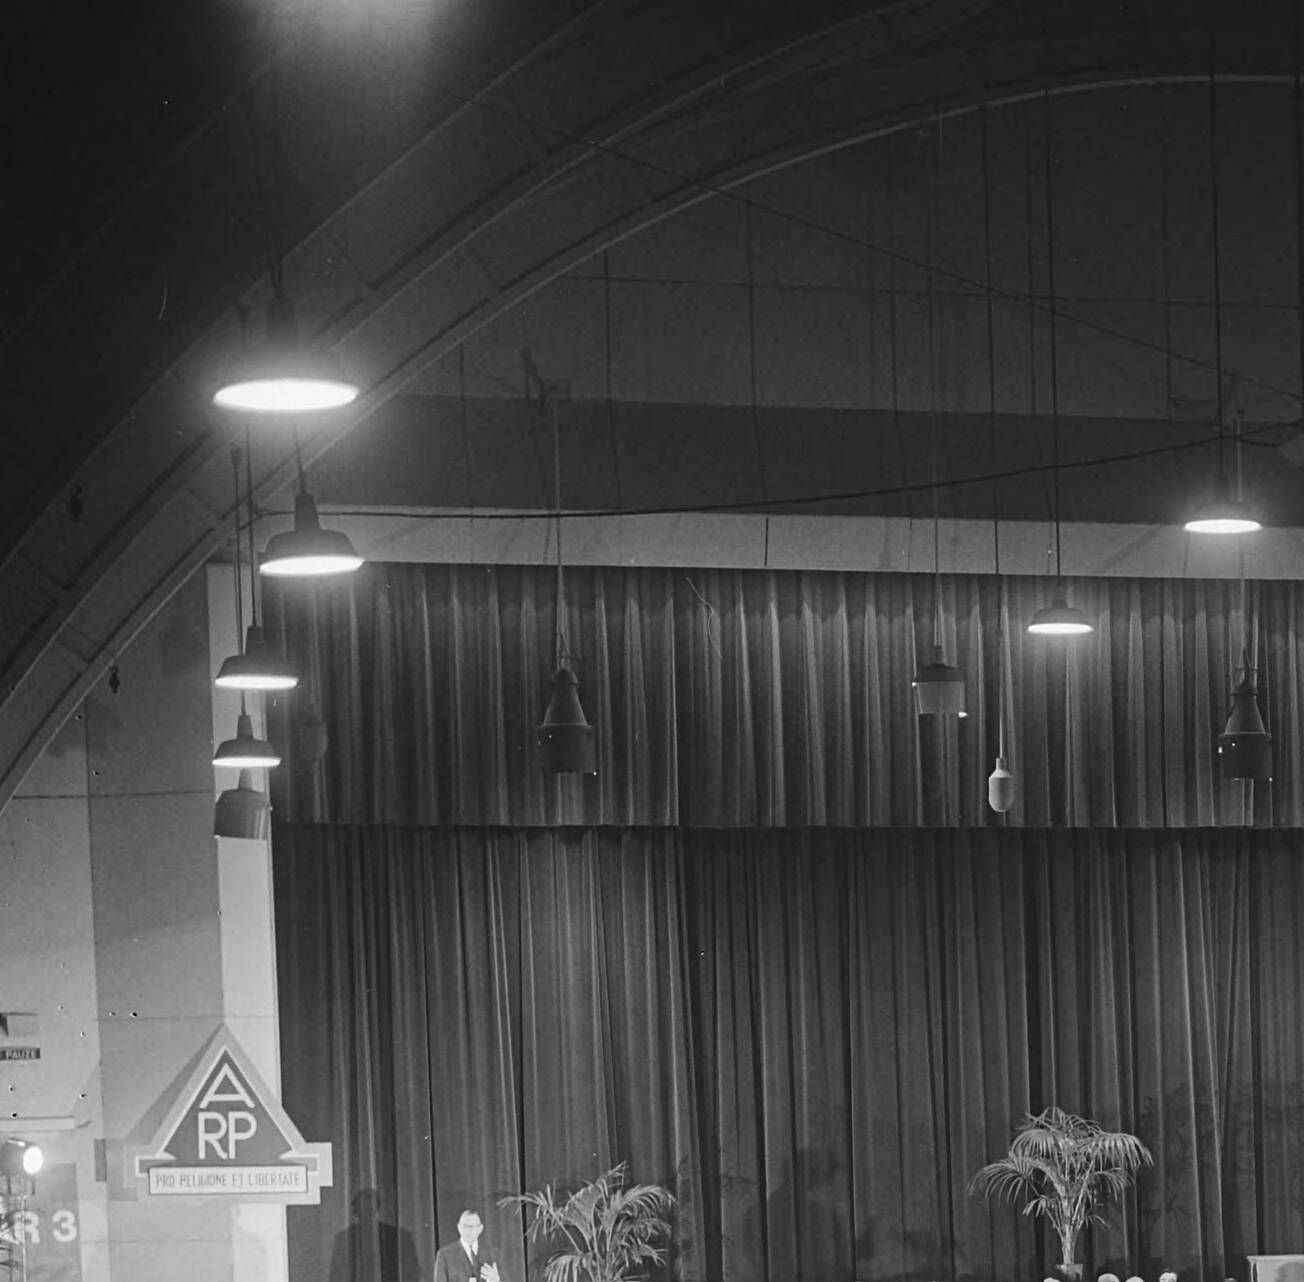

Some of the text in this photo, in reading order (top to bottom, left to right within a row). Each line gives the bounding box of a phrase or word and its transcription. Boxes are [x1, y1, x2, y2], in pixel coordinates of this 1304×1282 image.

[199, 1062, 256, 1109] A
[198, 1111, 257, 1160] RP
[155, 1171, 301, 1188] PRO RELIGIONE ET LIBERTATE
[52, 1210, 77, 1242] 3
